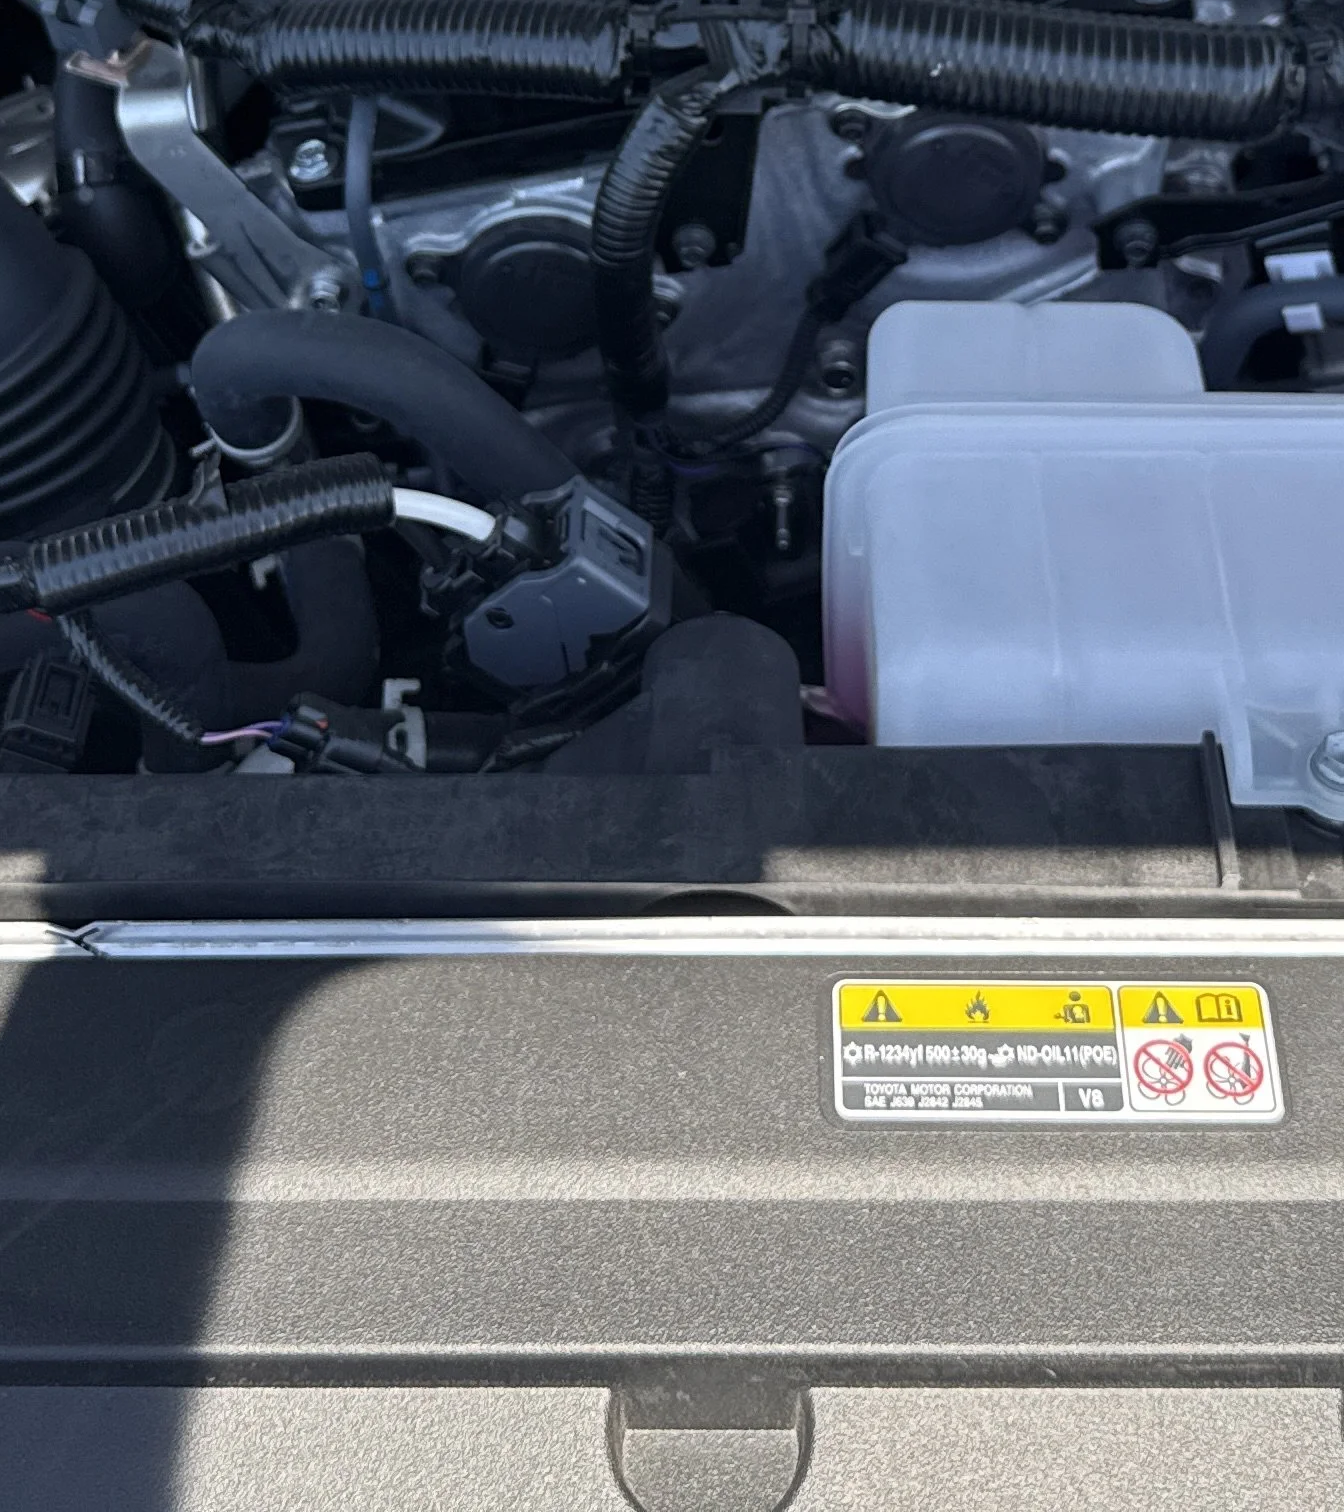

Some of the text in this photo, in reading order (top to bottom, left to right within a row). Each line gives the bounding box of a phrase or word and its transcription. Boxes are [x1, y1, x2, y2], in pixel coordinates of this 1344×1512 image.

[864, 1083, 1034, 1096] TOYOTA MOTOR CORPORATION
